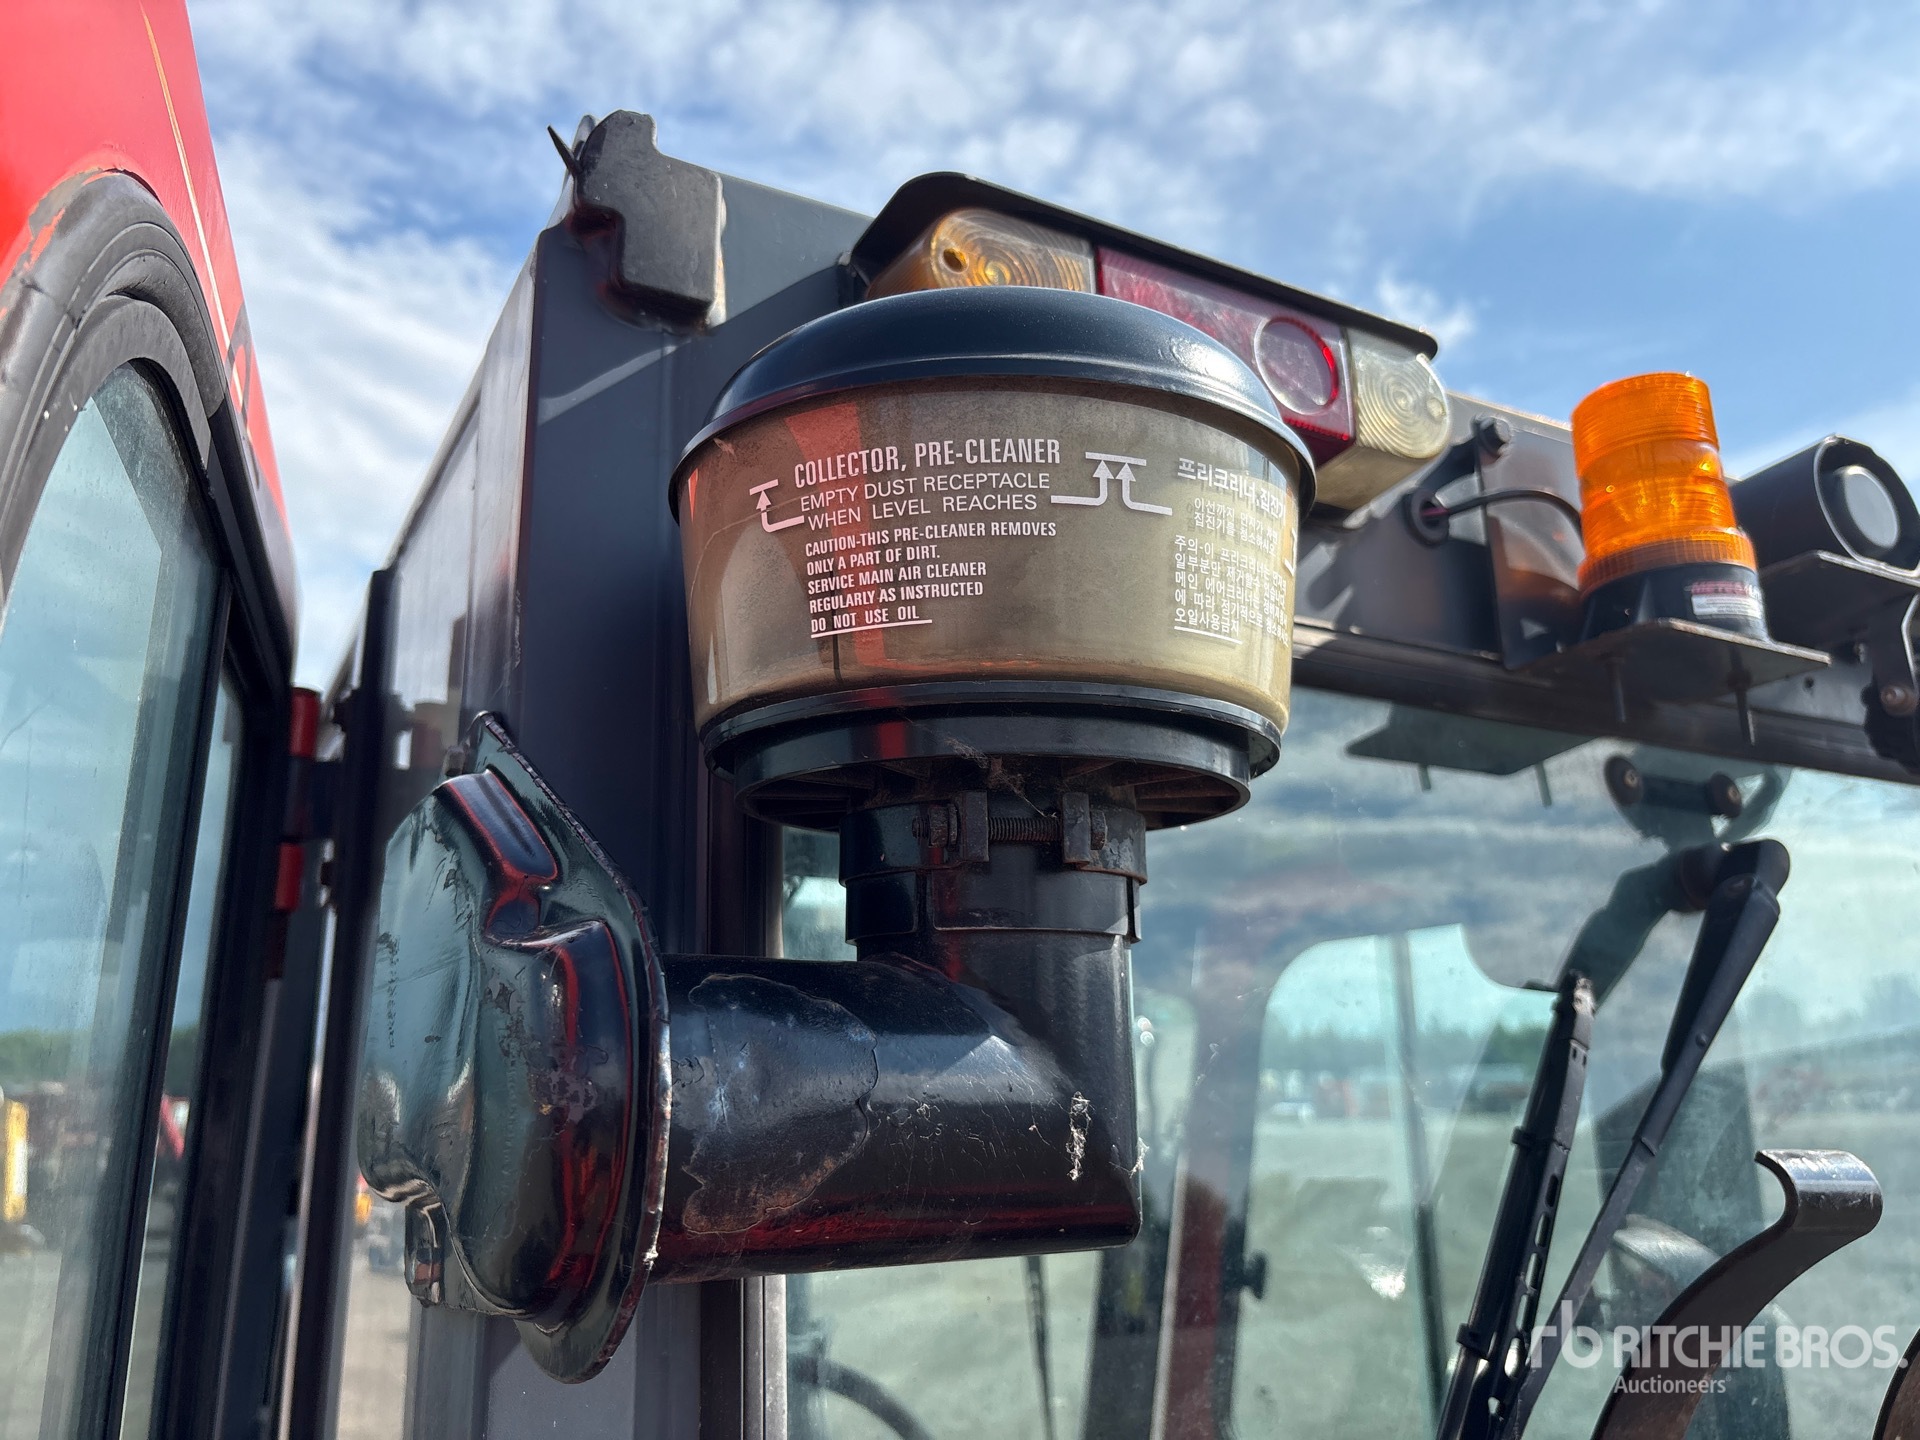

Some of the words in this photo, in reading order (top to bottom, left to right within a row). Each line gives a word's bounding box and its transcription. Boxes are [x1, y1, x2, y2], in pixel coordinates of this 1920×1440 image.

[794, 445, 907, 489] COLLECTOR,
[915, 438, 1061, 468] PRE-CLEANER
[800, 485, 859, 512] EMPTY
[864, 477, 918, 500] DUST
[923, 472, 1050, 492] RECEPTACLE
[807, 506, 861, 531] WHEN
[872, 498, 931, 520] LEVEL
[942, 494, 1037, 512] REACHES
[1194, 498, 1235, 519] 이선까지
[1194, 511, 1235, 537] 집진기를
[805, 530, 890, 557] CAUTION-THIS
[894, 522, 986, 542] PRE-CLEANER
[991, 521, 1057, 537] REMOVES
[806, 556, 835, 576] ONLY
[838, 556, 847, 571] A
[850, 550, 881, 568] PART
[885, 548, 902, 563] OF
[906, 544, 941, 561] DIRT.
[1174, 552, 1221, 578] 일부분만
[808, 573, 855, 595] SERVICE
[859, 568, 894, 586] MAIN
[898, 565, 922, 581] AIR
[926, 561, 987, 578] CLEANER
[1175, 571, 1198, 590] 메인
[809, 590, 875, 614] REGULARLY
[879, 587, 897, 603] AS
[901, 581, 984, 600] INSTRUCTED
[1174, 589, 1186, 606] 에
[1193, 592, 1216, 613] 따라
[1221, 598, 1263, 628] 정기적으로
[811, 617, 826, 633] DO
[833, 612, 857, 629] NOT
[865, 608, 889, 624] USE
[897, 605, 920, 621] OIL
[1174, 607, 1239, 637] 오일사용금지
